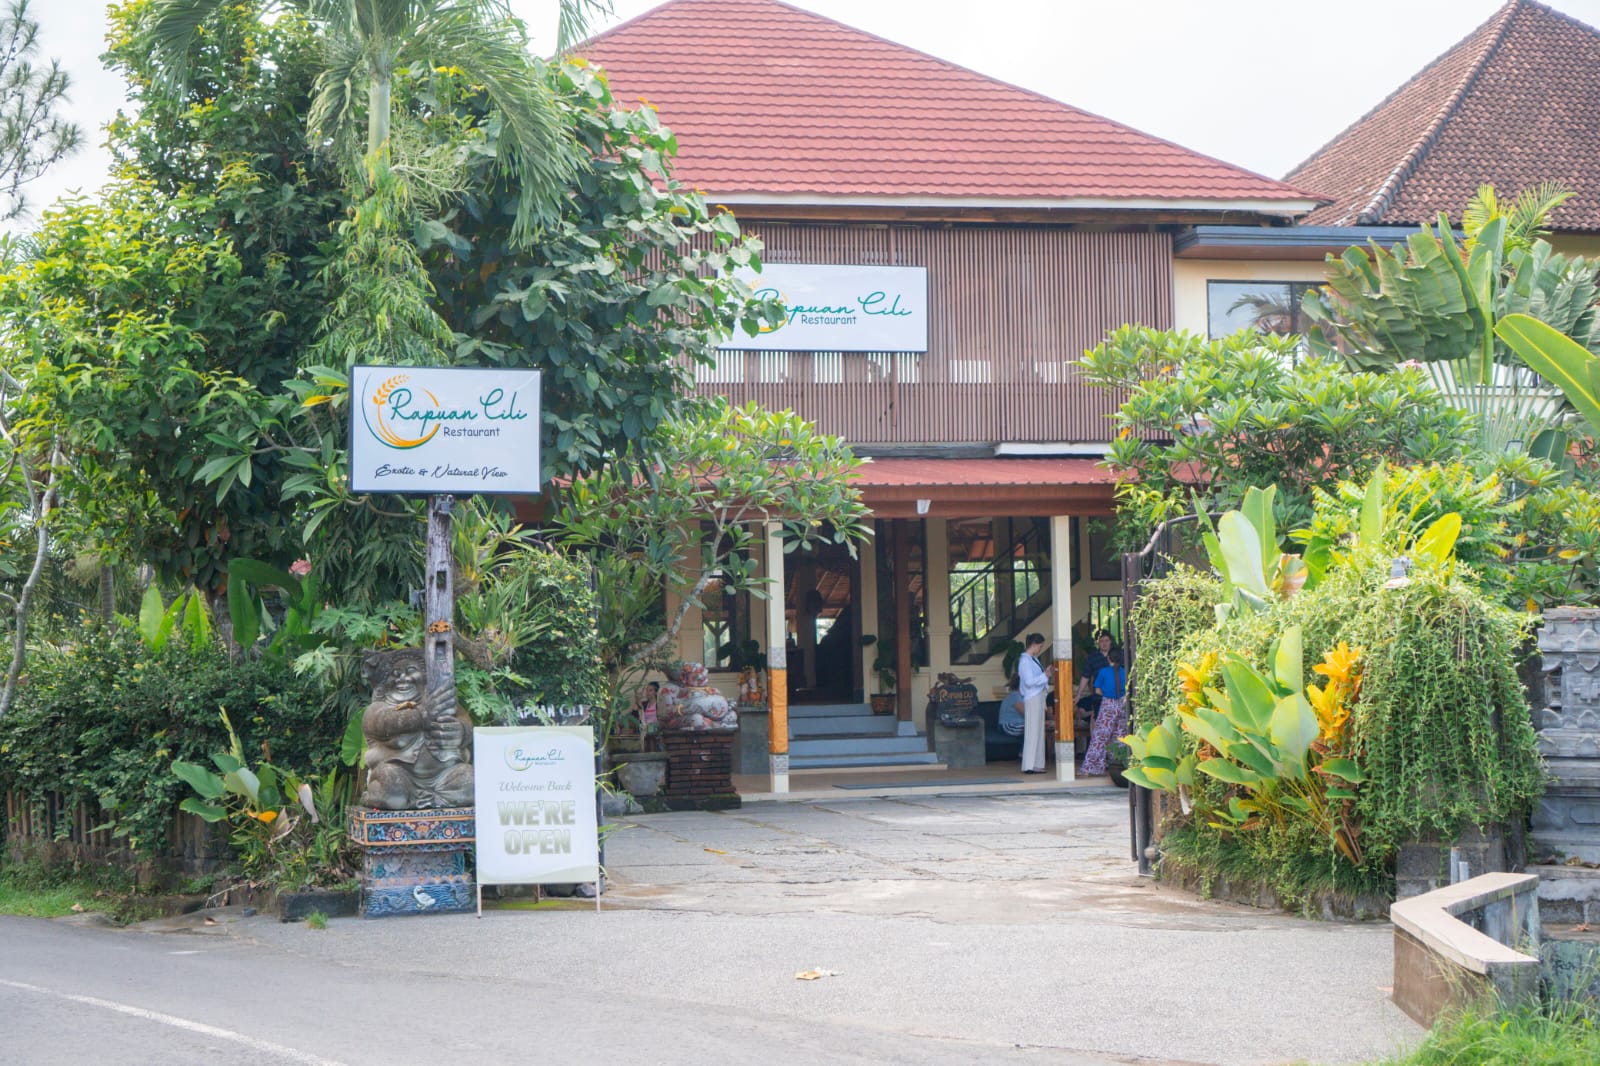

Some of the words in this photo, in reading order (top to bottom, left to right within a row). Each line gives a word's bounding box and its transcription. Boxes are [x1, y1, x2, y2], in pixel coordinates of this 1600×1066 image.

[857, 291, 913, 316] Cili
[801, 314, 857, 325] Restaurant
[388, 388, 478, 437] Rapuan
[479, 388, 528, 420] Cili
[443, 426, 500, 437] Restaurant
[374, 463, 416, 479] Exotic
[418, 468, 428, 477] &
[431, 463, 480, 479] Natural
[481, 466, 508, 480] View
[513, 748, 547, 766] Rapuan
[498, 780, 545, 792] Welcome
[547, 780, 572, 792] Back
[496, 799, 576, 826] WE'RE
[503, 829, 572, 855] OPEN
